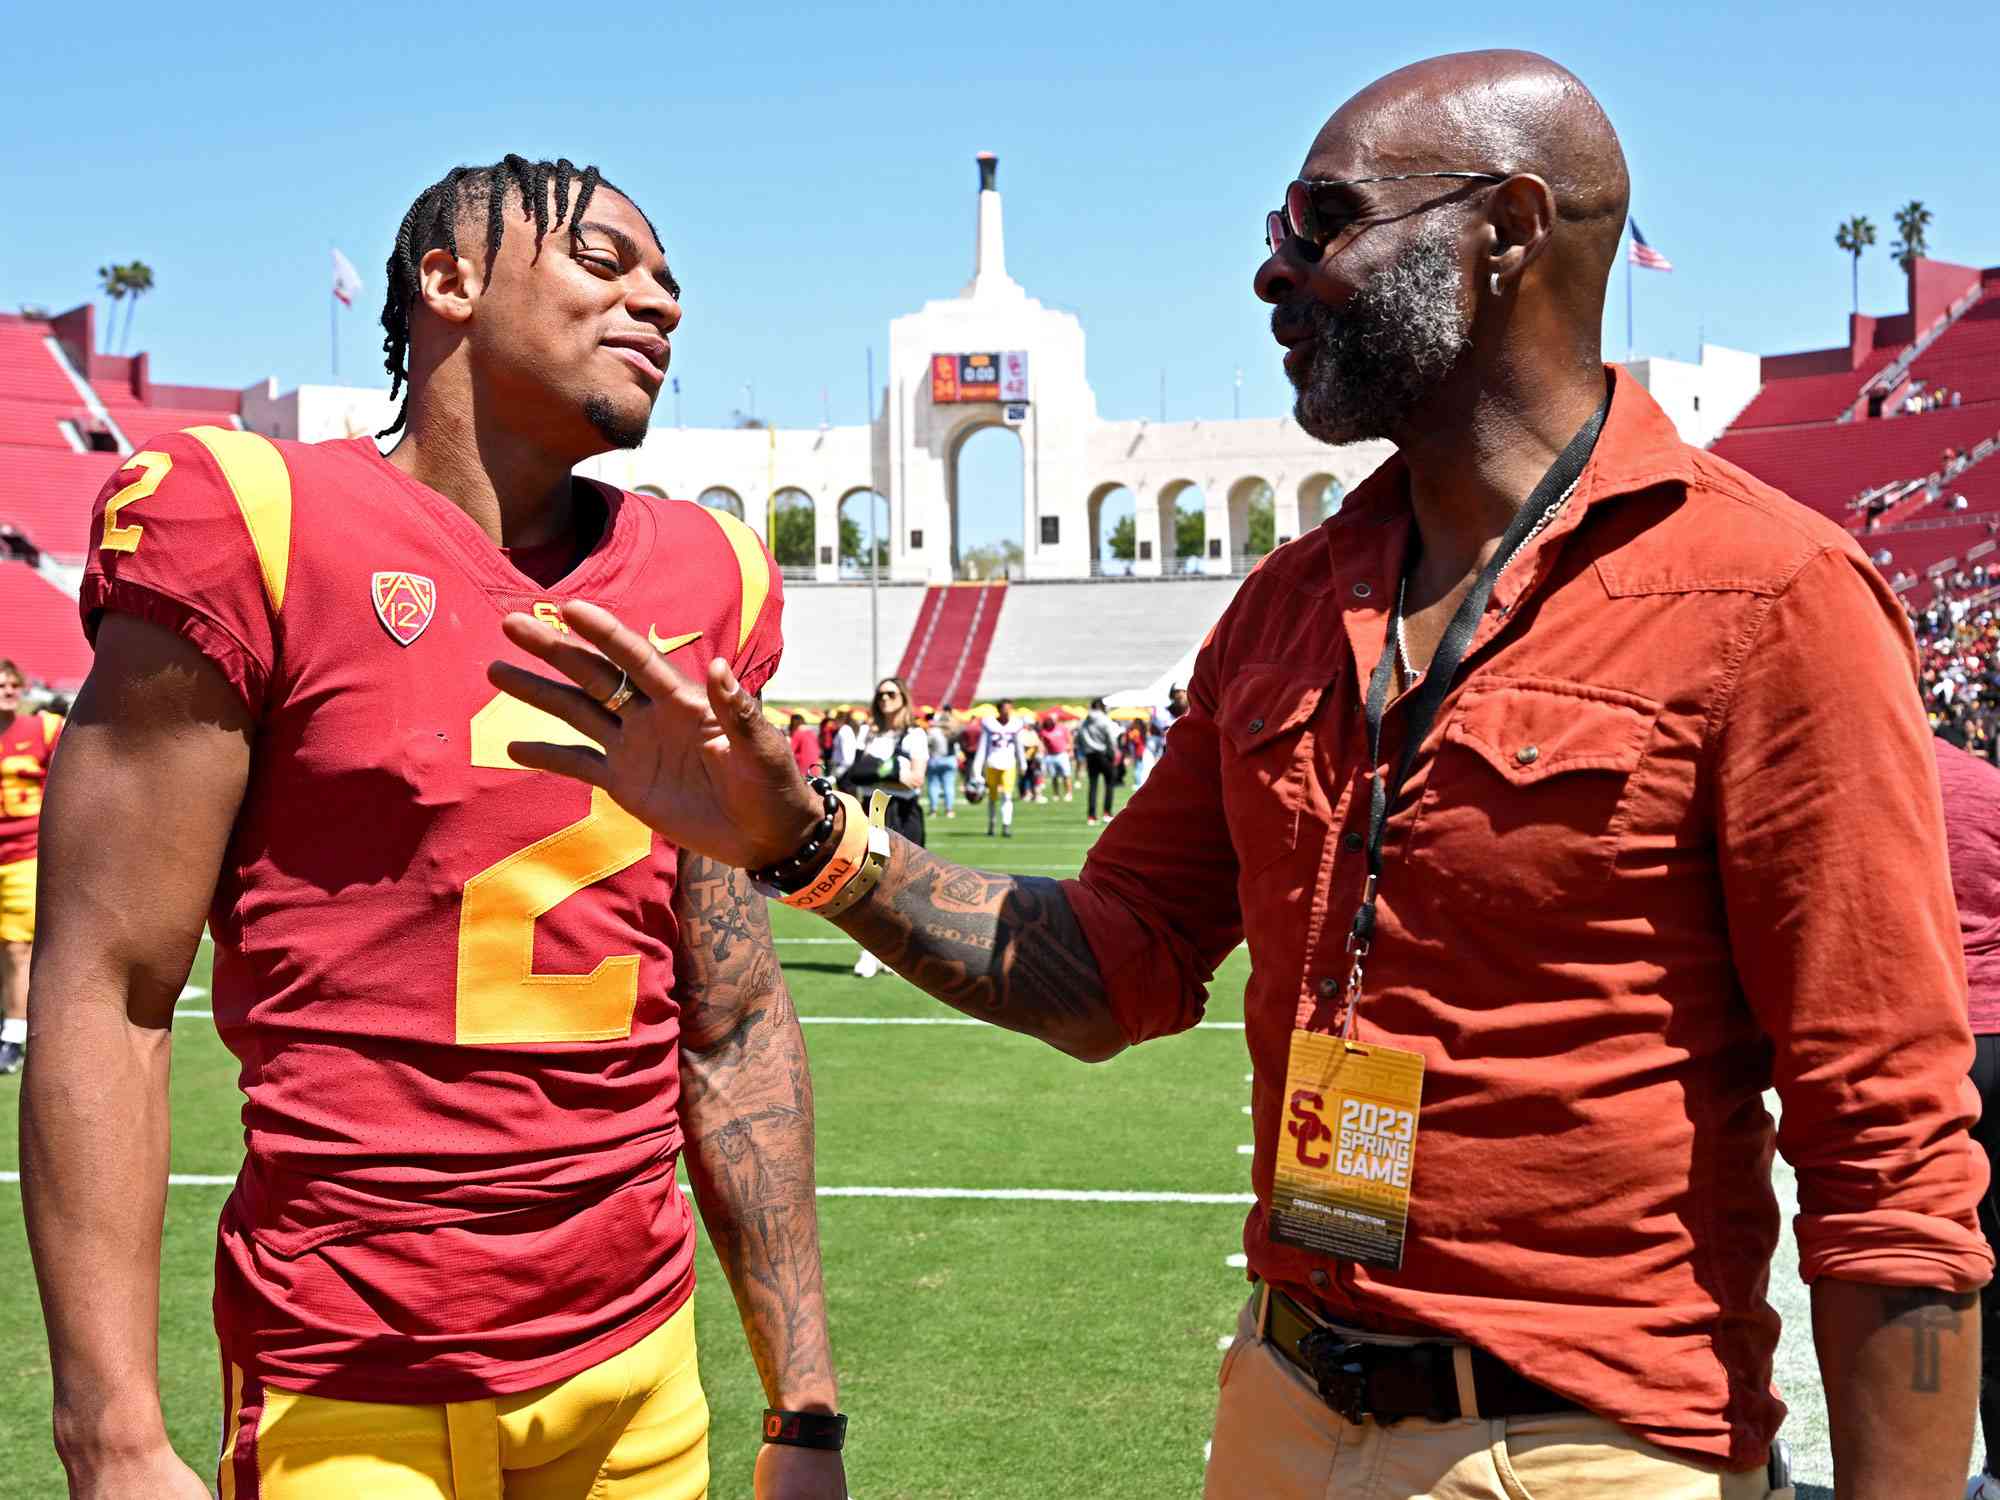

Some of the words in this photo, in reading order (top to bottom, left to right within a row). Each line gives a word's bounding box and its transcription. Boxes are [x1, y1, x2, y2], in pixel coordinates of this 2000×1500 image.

[99, 449, 174, 554] 2
[375, 573, 432, 616] PAC
[389, 601, 421, 629] 12
[455, 690, 653, 1045] 2
[1287, 1088, 1332, 1169] SC
[1342, 1099, 1414, 1142] 2023
[1339, 1131, 1411, 1161] SPRING
[1336, 1149, 1409, 1189] GAME
